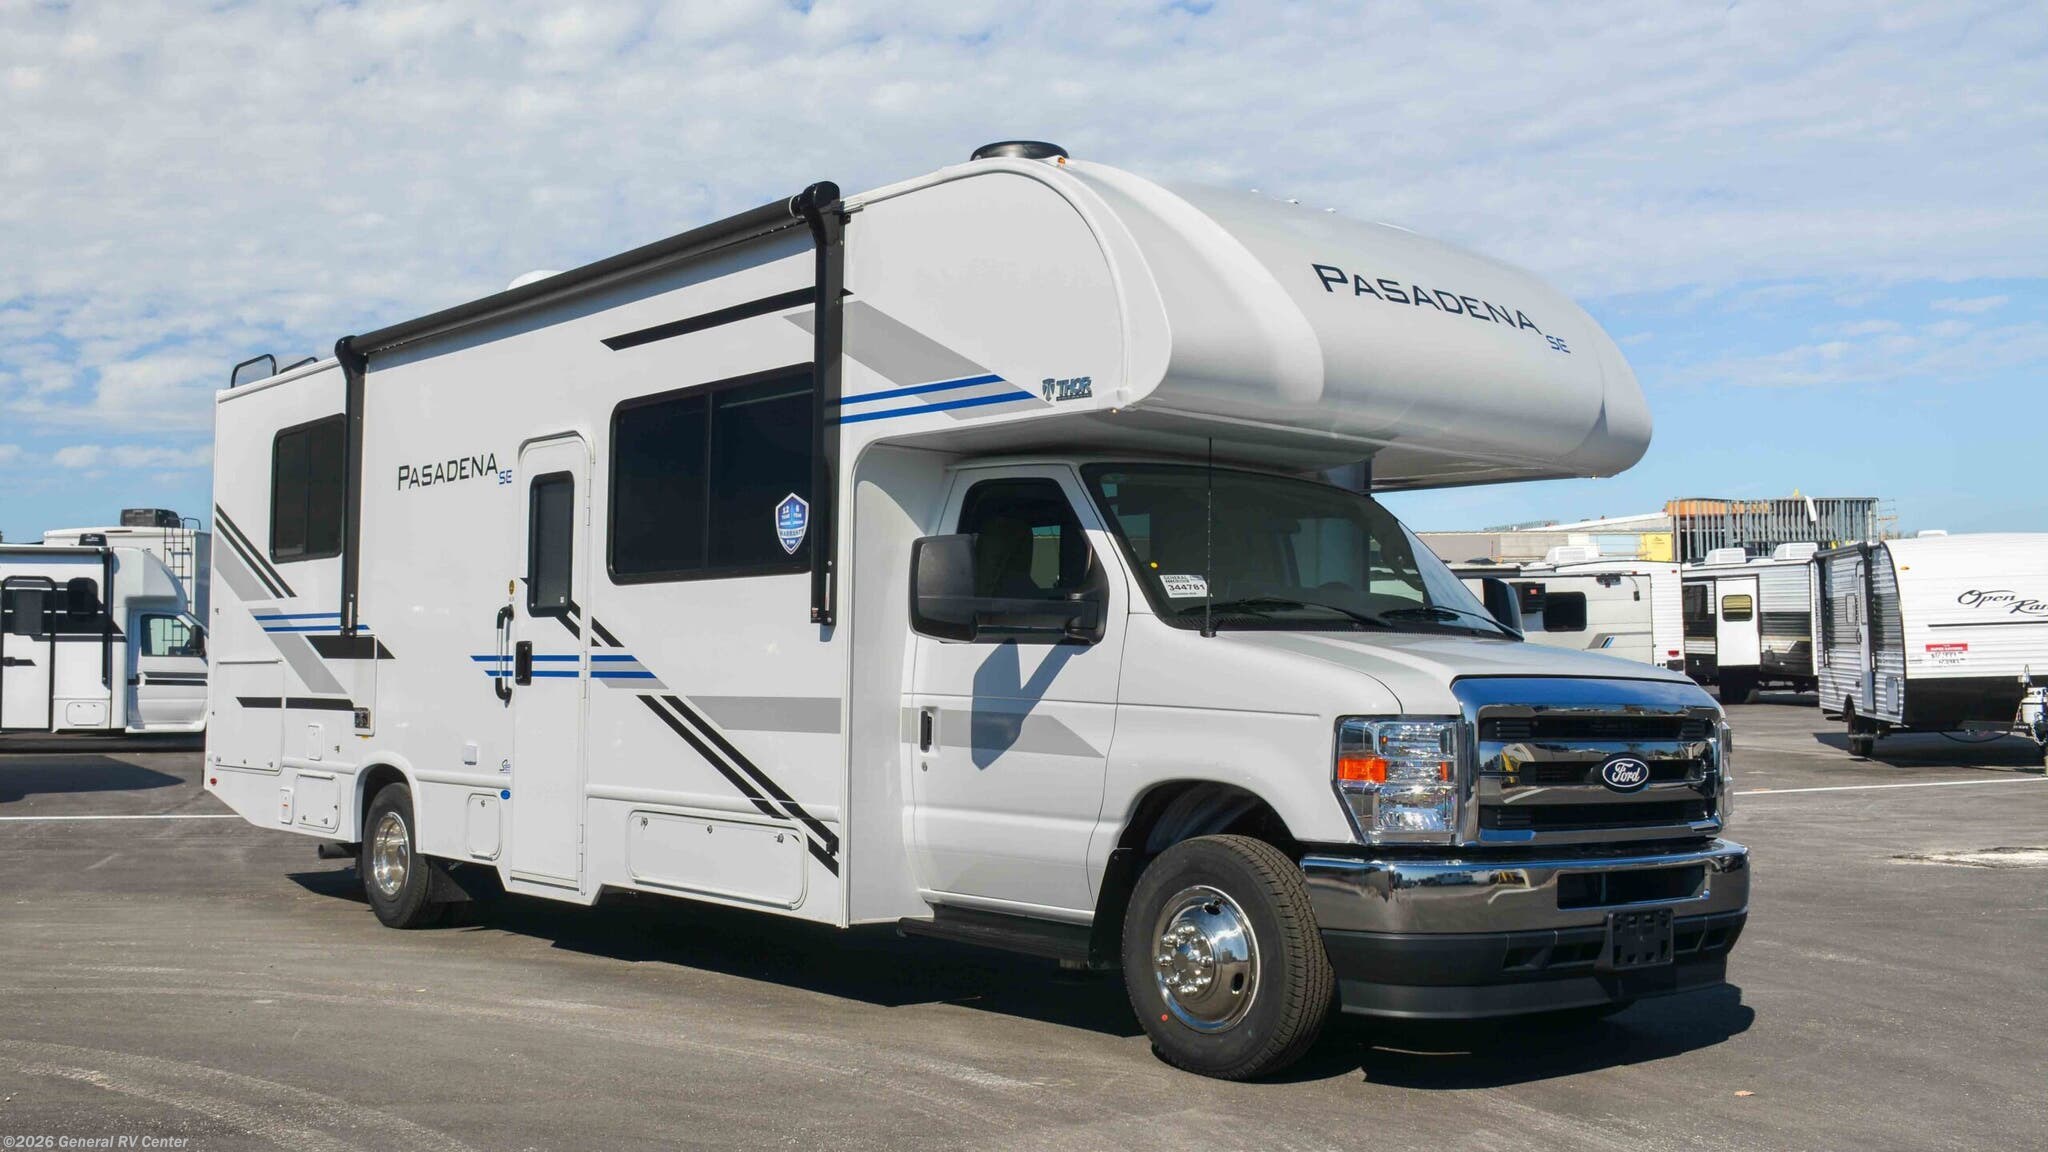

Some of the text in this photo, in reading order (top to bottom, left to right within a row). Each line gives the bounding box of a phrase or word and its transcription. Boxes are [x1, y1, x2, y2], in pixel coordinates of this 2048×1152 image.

[1311, 263, 1572, 354] PASADENA SE
[1056, 376, 1092, 396] THOR
[397, 452, 513, 491] PASADENA SE
[1957, 589, 2016, 608] Open
[2003, 599, 2048, 617] Ran
[1612, 762, 1641, 782] Ford
